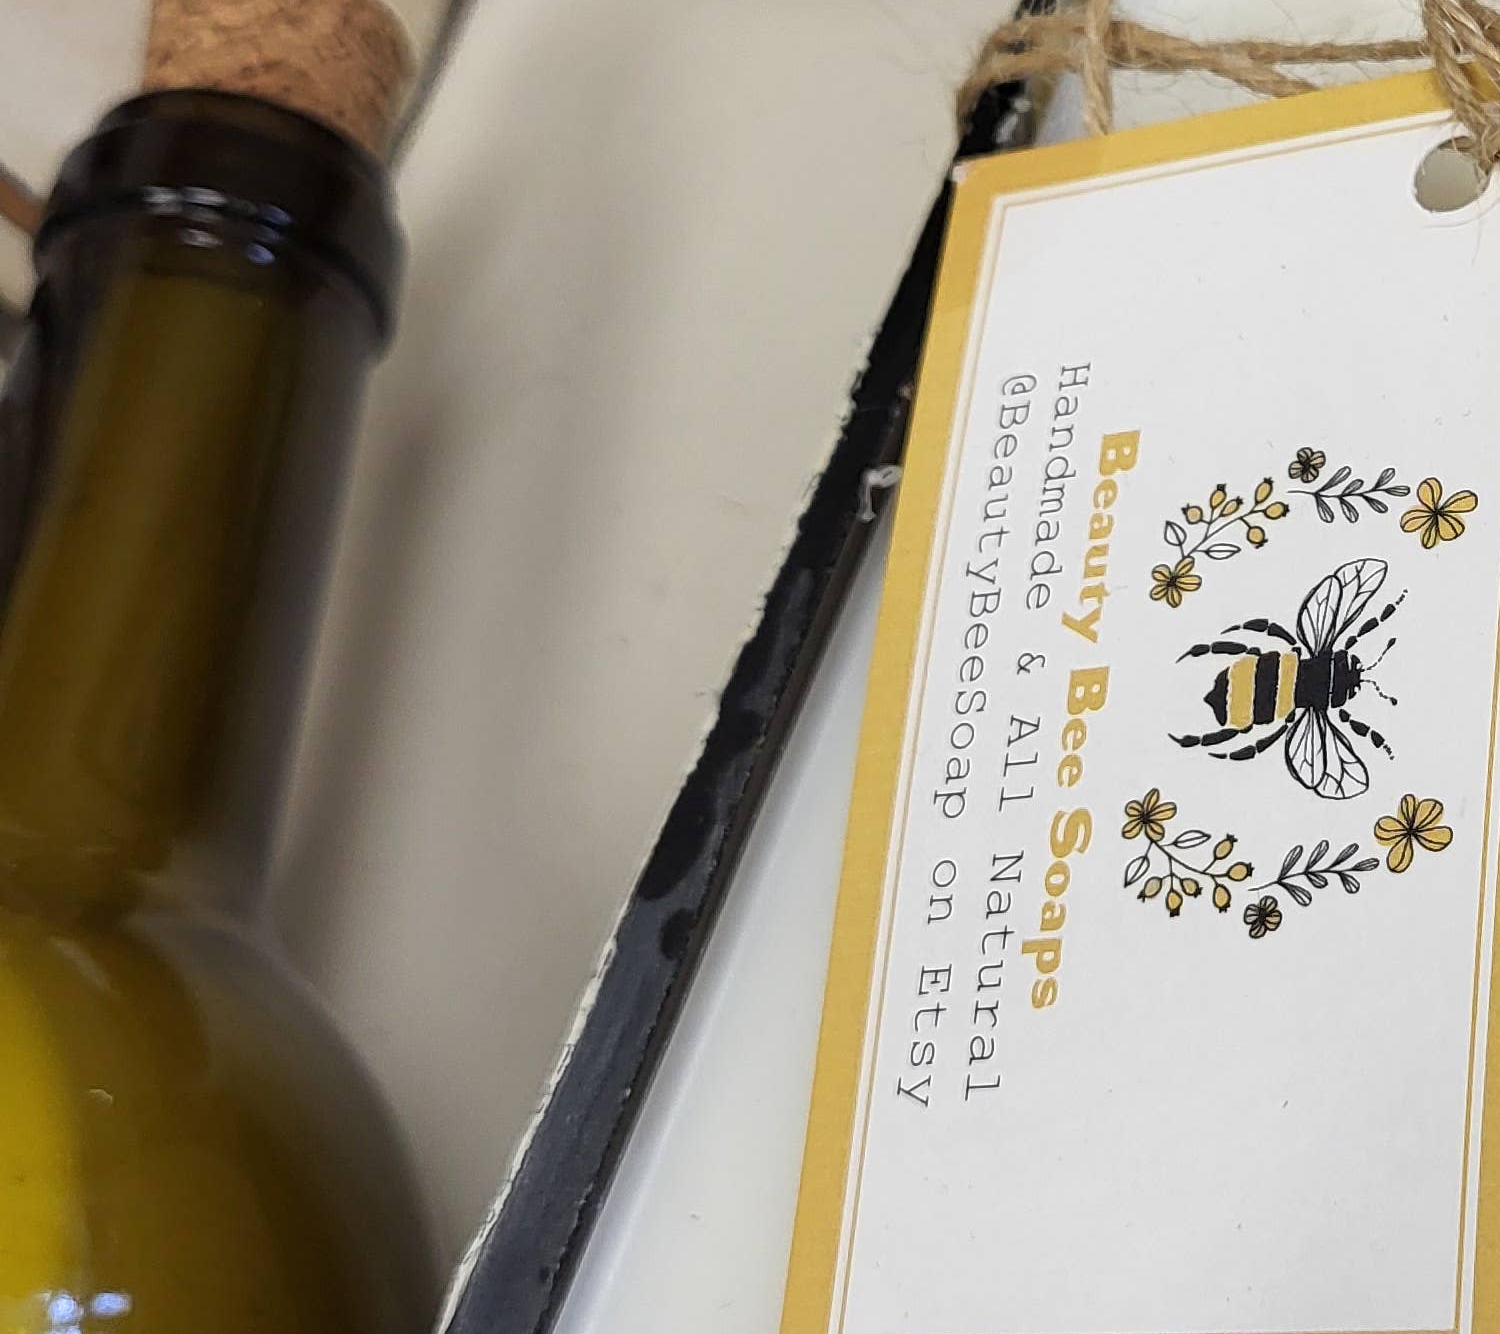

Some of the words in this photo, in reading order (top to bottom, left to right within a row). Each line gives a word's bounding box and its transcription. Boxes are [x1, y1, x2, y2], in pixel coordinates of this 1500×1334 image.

[1026, 362, 1091, 610] Handmade
[1061, 429, 1141, 644] Beauty
[933, 374, 1037, 819] @BeautyBeeSoap
[1016, 652, 1046, 676] &
[999, 714, 1041, 812] All
[1057, 666, 1110, 788] Bee
[928, 859, 957, 925] on
[965, 850, 1024, 1101] Natural
[1022, 807, 1093, 1009] Soaps
[897, 963, 952, 1107] Etsy
